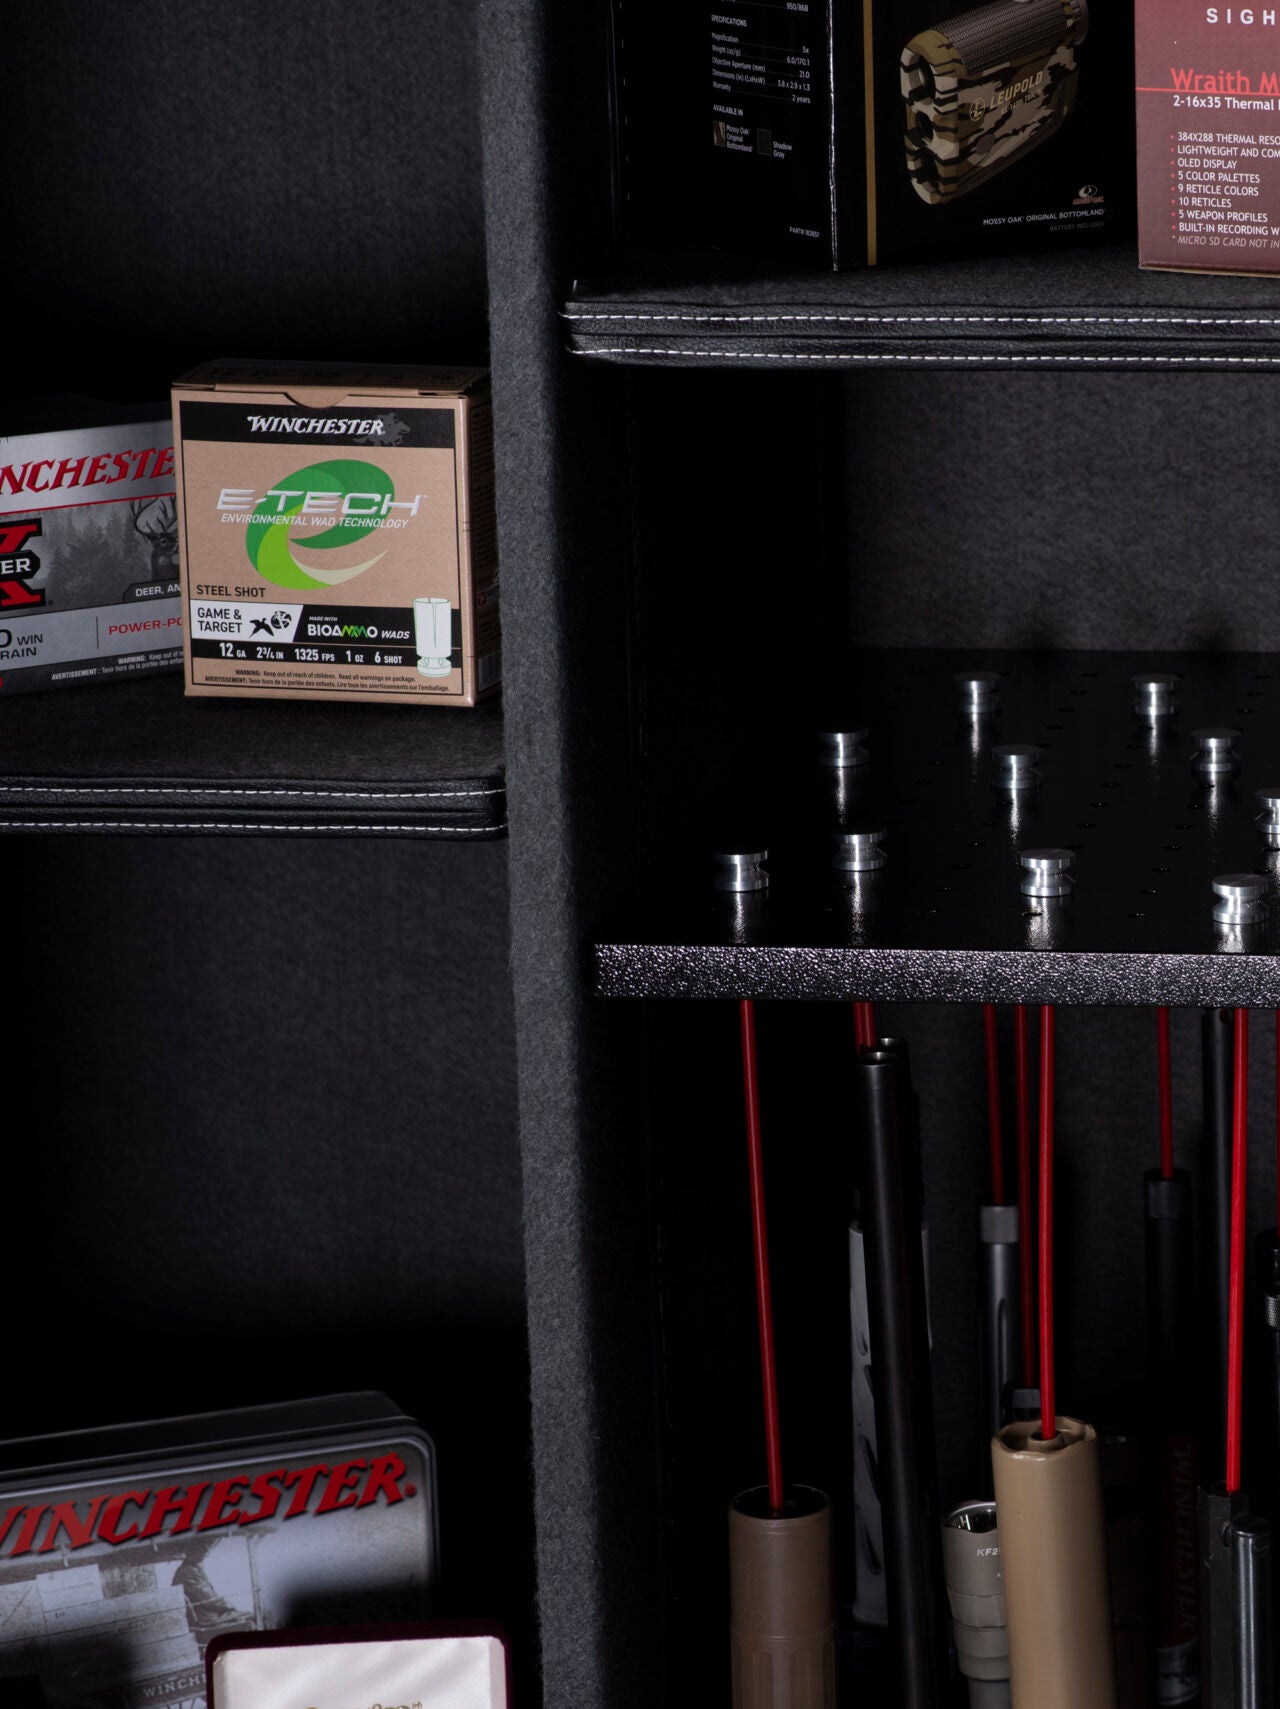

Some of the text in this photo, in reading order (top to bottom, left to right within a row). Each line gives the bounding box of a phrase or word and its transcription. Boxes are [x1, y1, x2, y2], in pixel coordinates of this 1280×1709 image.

[1170, 68, 1250, 93] Wraith
[990, 71, 1043, 109] LEUPOLD
[1173, 95, 1221, 109] 2-16x35
[1224, 97, 1274, 111] Thermal
[1177, 131, 1214, 143] 384X288
[1216, 133, 1257, 145] THERMAL
[1177, 145, 1239, 156] LIGHTWEIGHT
[1240, 147, 1259, 157] AND
[1178, 157, 1238, 170] OLED DISPLAY
[1186, 171, 1216, 182] COLOR
[1218, 172, 1261, 183] PALETTES
[1186, 184, 1222, 195] RETICLE
[1224, 185, 1259, 196] COLORS
[1179, 196, 1232, 208] 10 RETICLES
[983, 208, 1104, 226] MOSSY OAK ORIGINAL BOTTOMLAND
[1186, 210, 1225, 220] WEAPON
[1227, 211, 1268, 222] PROFILES
[1179, 222, 1215, 233] BUILT-IN
[1217, 224, 1268, 236] RECORDING
[1177, 235, 1207, 246] MICRO
[1209, 236, 1220, 246] SD
[1222, 237, 1247, 247] CARD
[1249, 238, 1268, 248] NOT
[247, 415, 384, 435] WINCHESTER
[0, 447, 174, 495] NCHESTE
[216, 488, 423, 517] E-TECH
[220, 513, 409, 529] ENVIRONMENTAL WAD TECHNOLOGY
[135, 587, 164, 597] DEER,
[196, 584, 266, 597] STEEL SHOT
[197, 607, 242, 620] GAME &
[198, 620, 242, 633] TARGET
[307, 624, 411, 639] BIOAMMO WADS
[17, 634, 43, 646] WIN
[219, 642, 234, 657] 12
[294, 648, 319, 660] 1325
[321, 653, 335, 662] FPS
[354, 654, 364, 663] OZ
[374, 651, 381, 662] 6
[384, 655, 402, 664] SHOT
[235, 669, 261, 677] WARNING:
[360, 674, 384, 682] warnings
[392, 675, 415, 683] package.
